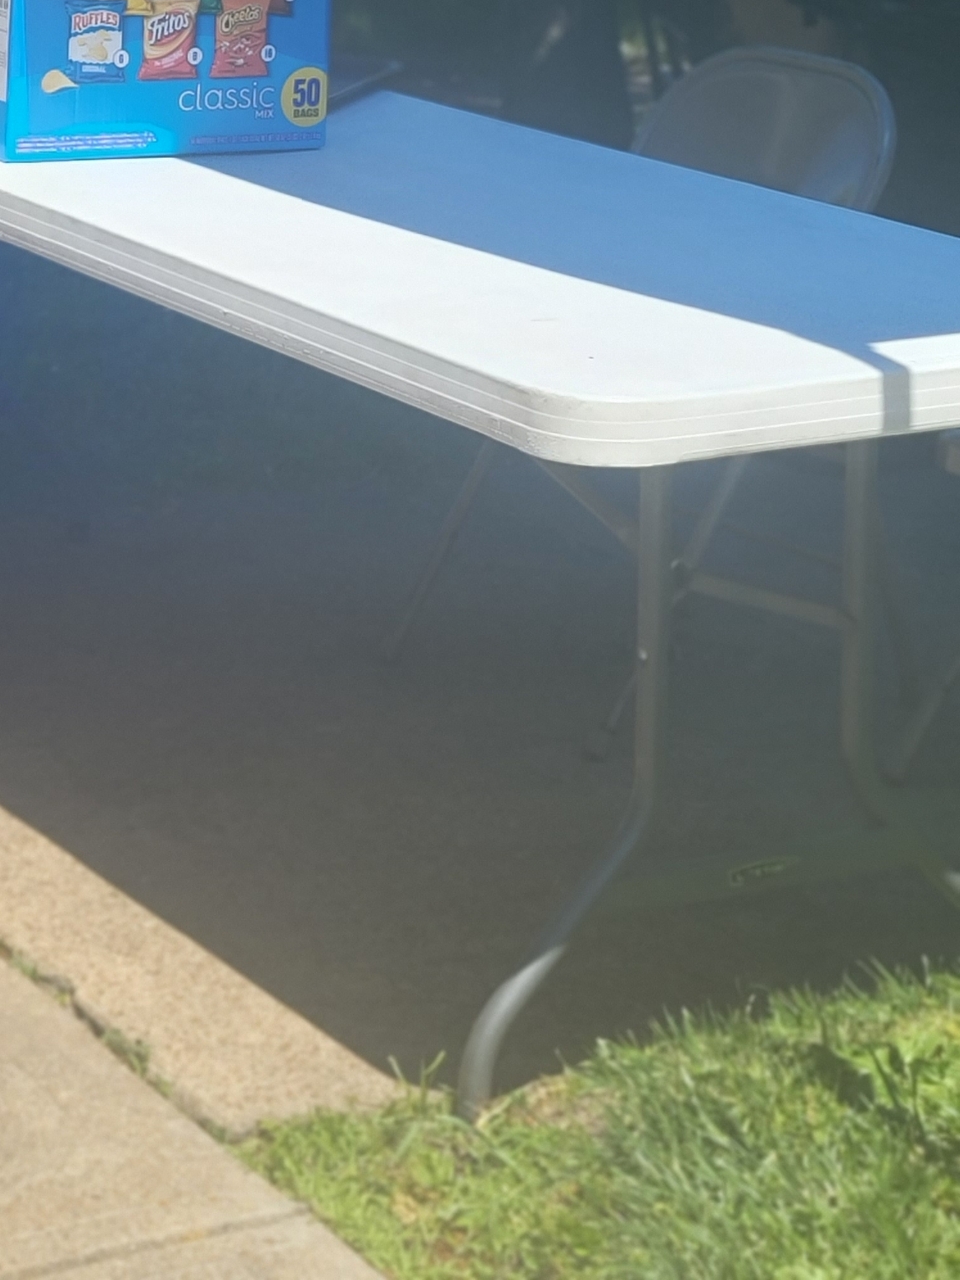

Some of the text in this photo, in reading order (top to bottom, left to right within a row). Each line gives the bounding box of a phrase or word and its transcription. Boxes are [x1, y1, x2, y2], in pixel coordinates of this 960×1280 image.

[71, 10, 120, 33] RUFFLES
[147, 11, 191, 46] Fritos
[221, 5, 261, 33] Cheetos
[179, 81, 276, 111] classic
[292, 77, 321, 108] 50
[254, 109, 275, 119] MIX
[293, 108, 320, 119] BAGS
